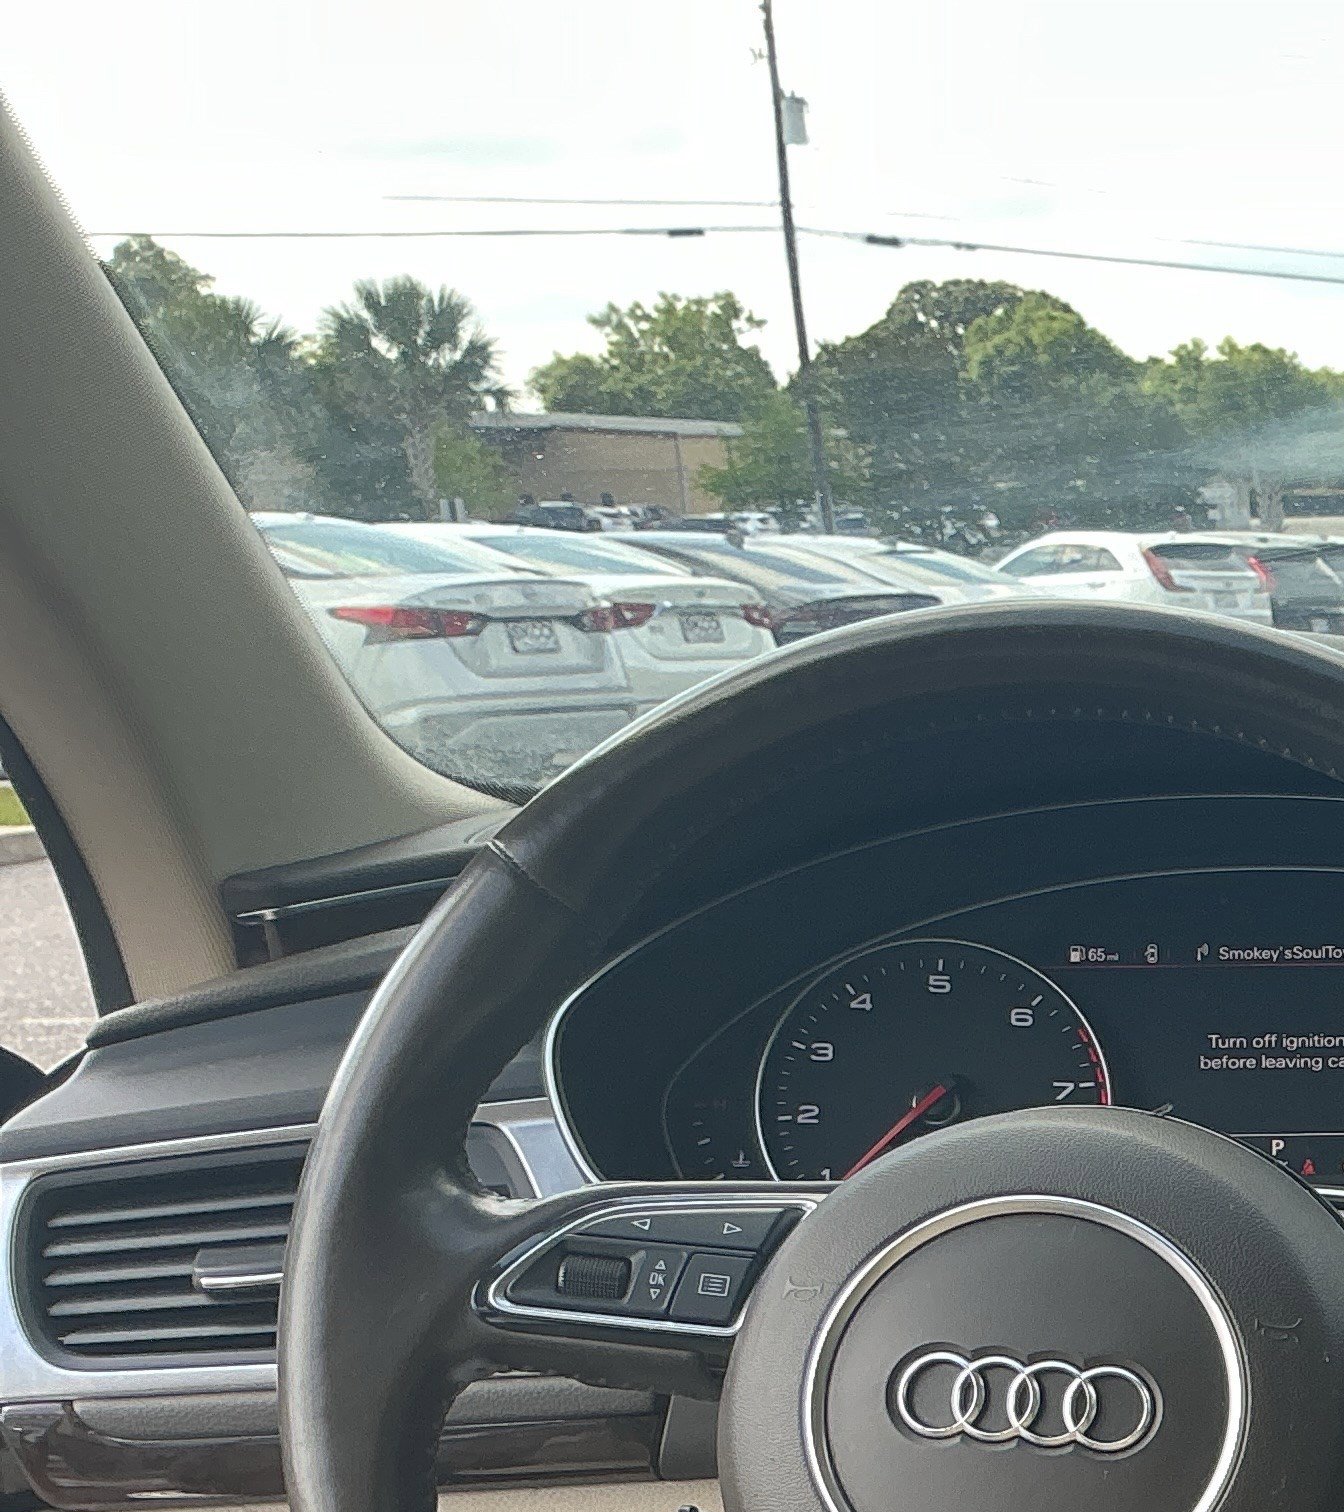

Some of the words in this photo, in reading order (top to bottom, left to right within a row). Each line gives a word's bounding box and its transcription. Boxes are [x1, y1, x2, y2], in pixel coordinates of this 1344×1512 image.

[927, 975, 951, 993] 5
[850, 993, 873, 1011] 4
[1010, 1008, 1034, 1026] 6
[1207, 1034, 1248, 1048] Turn
[1252, 1033, 1279, 1048] off
[810, 1043, 834, 1061] 3
[1200, 1054, 1257, 1070] before
[1261, 1054, 1323, 1072] leaving
[1052, 1081, 1076, 1100] 7
[797, 1104, 820, 1123] 2
[1271, 1139, 1285, 1156] P
[649, 1272, 665, 1287] OK
